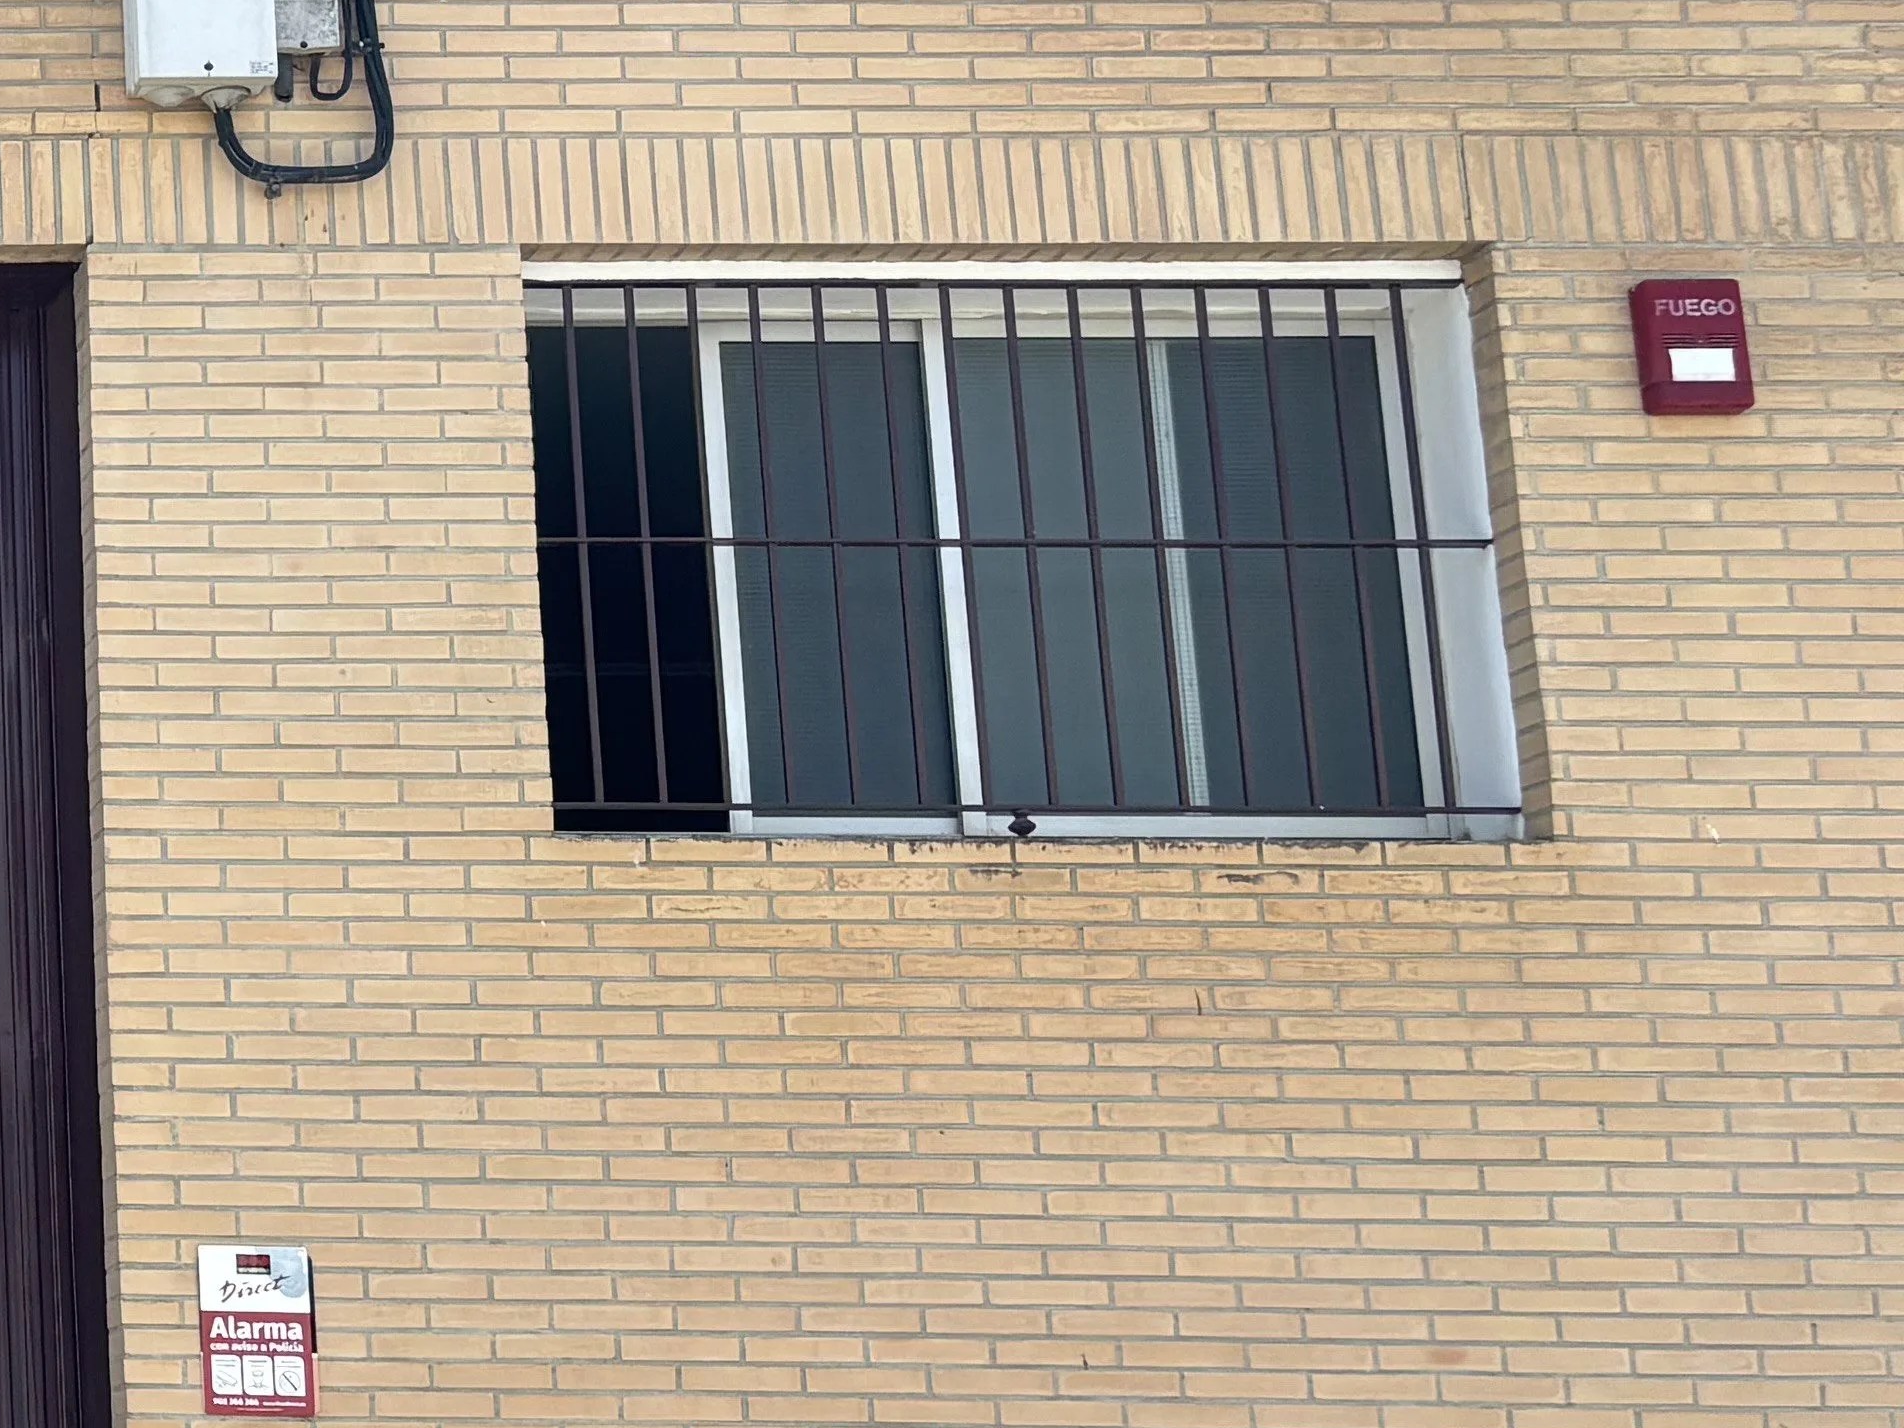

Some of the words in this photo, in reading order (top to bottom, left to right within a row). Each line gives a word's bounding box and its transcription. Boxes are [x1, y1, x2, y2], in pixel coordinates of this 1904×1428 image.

[1654, 298, 1736, 317] FUEGO
[220, 1275, 290, 1303] Direct
[210, 1316, 304, 1340] Alarma
